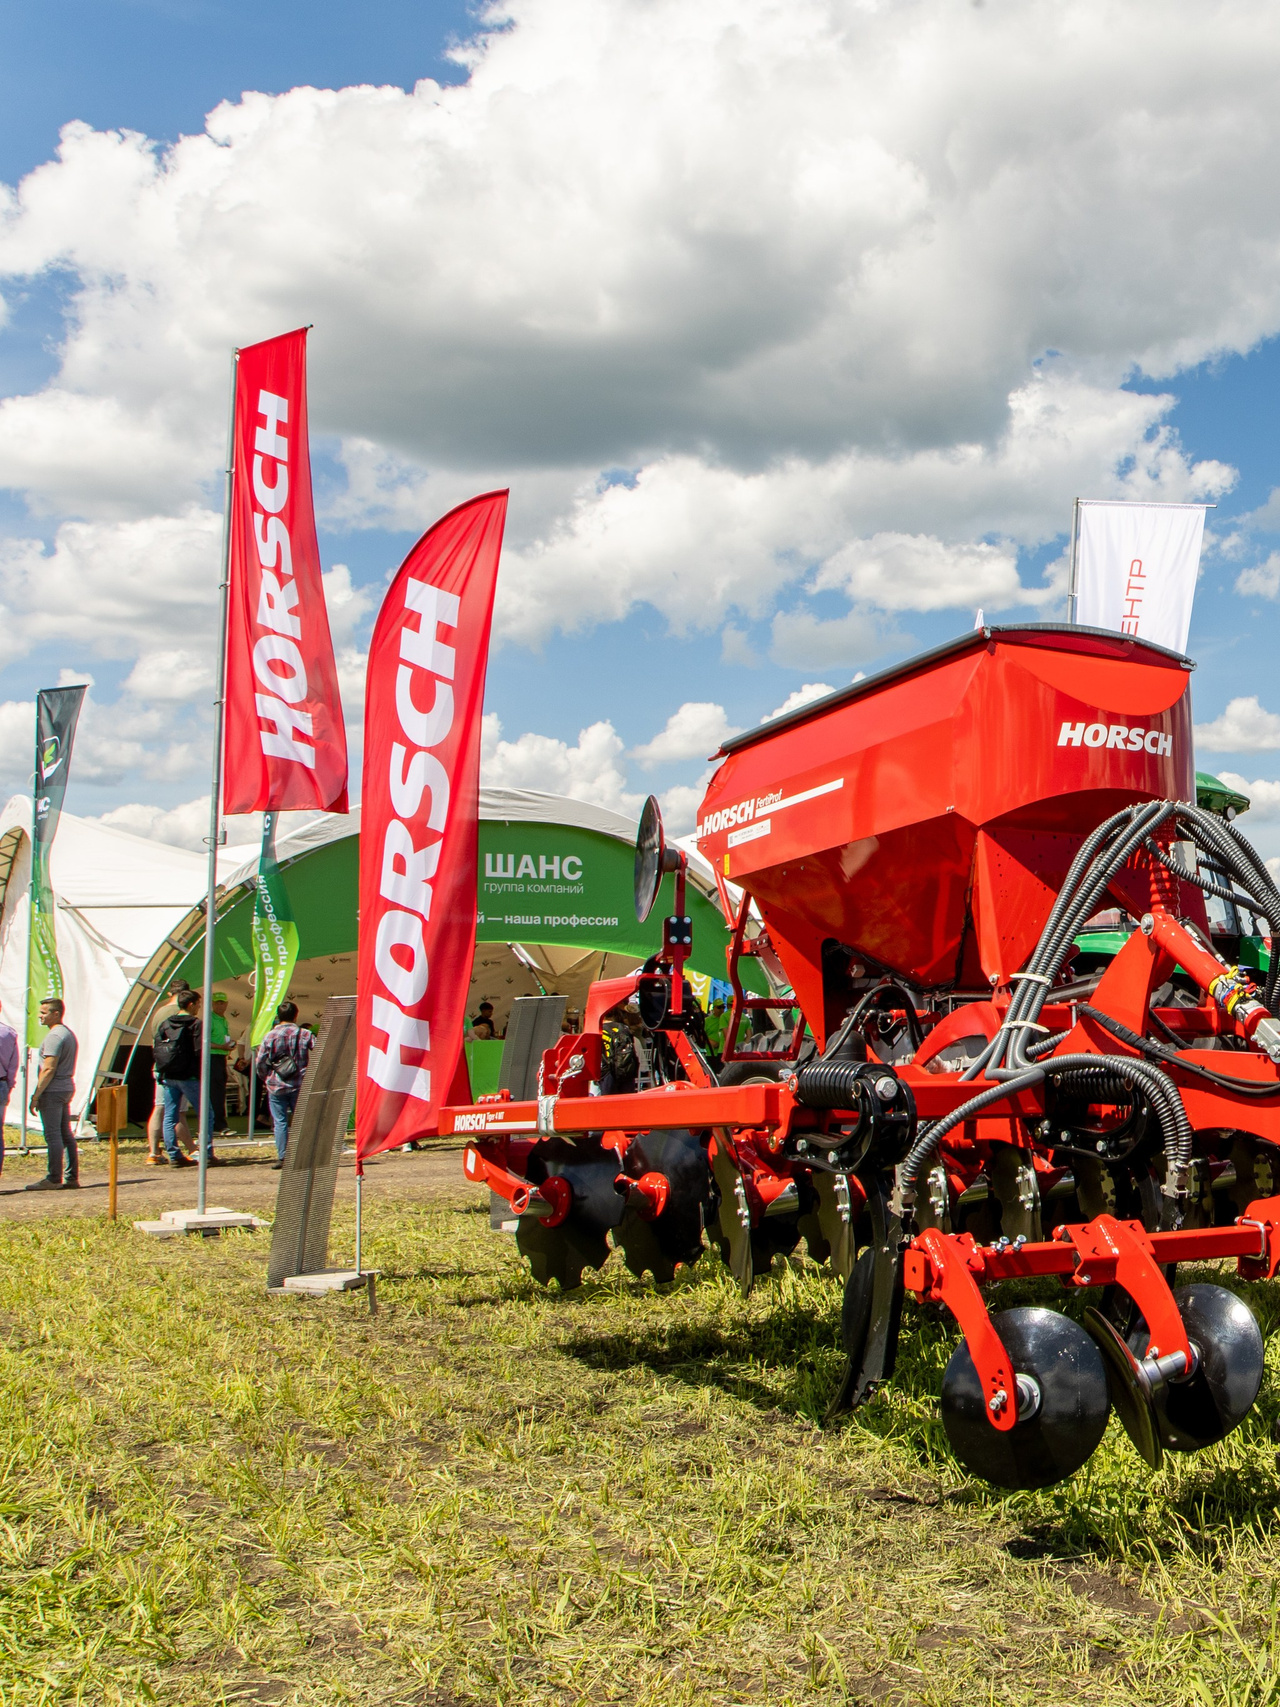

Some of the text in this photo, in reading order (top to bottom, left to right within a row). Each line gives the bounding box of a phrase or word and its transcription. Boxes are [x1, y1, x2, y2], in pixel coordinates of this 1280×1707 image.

[252, 389, 316, 769] HORSCH
[1121, 559, 1146, 637] ЕНТР
[1057, 722, 1173, 757] HORSCH
[703, 799, 755, 837] HORSCH
[366, 577, 461, 1101] HORSCH
[484, 853, 583, 881] ШАНС
[483, 882, 584, 894] группа компаний
[258, 875, 288, 966] профессия
[504, 914, 541, 925] наша
[544, 914, 619, 927] профессия
[454, 1113, 486, 1132] HORSCH
[486, 1112, 495, 1122] Tiger
